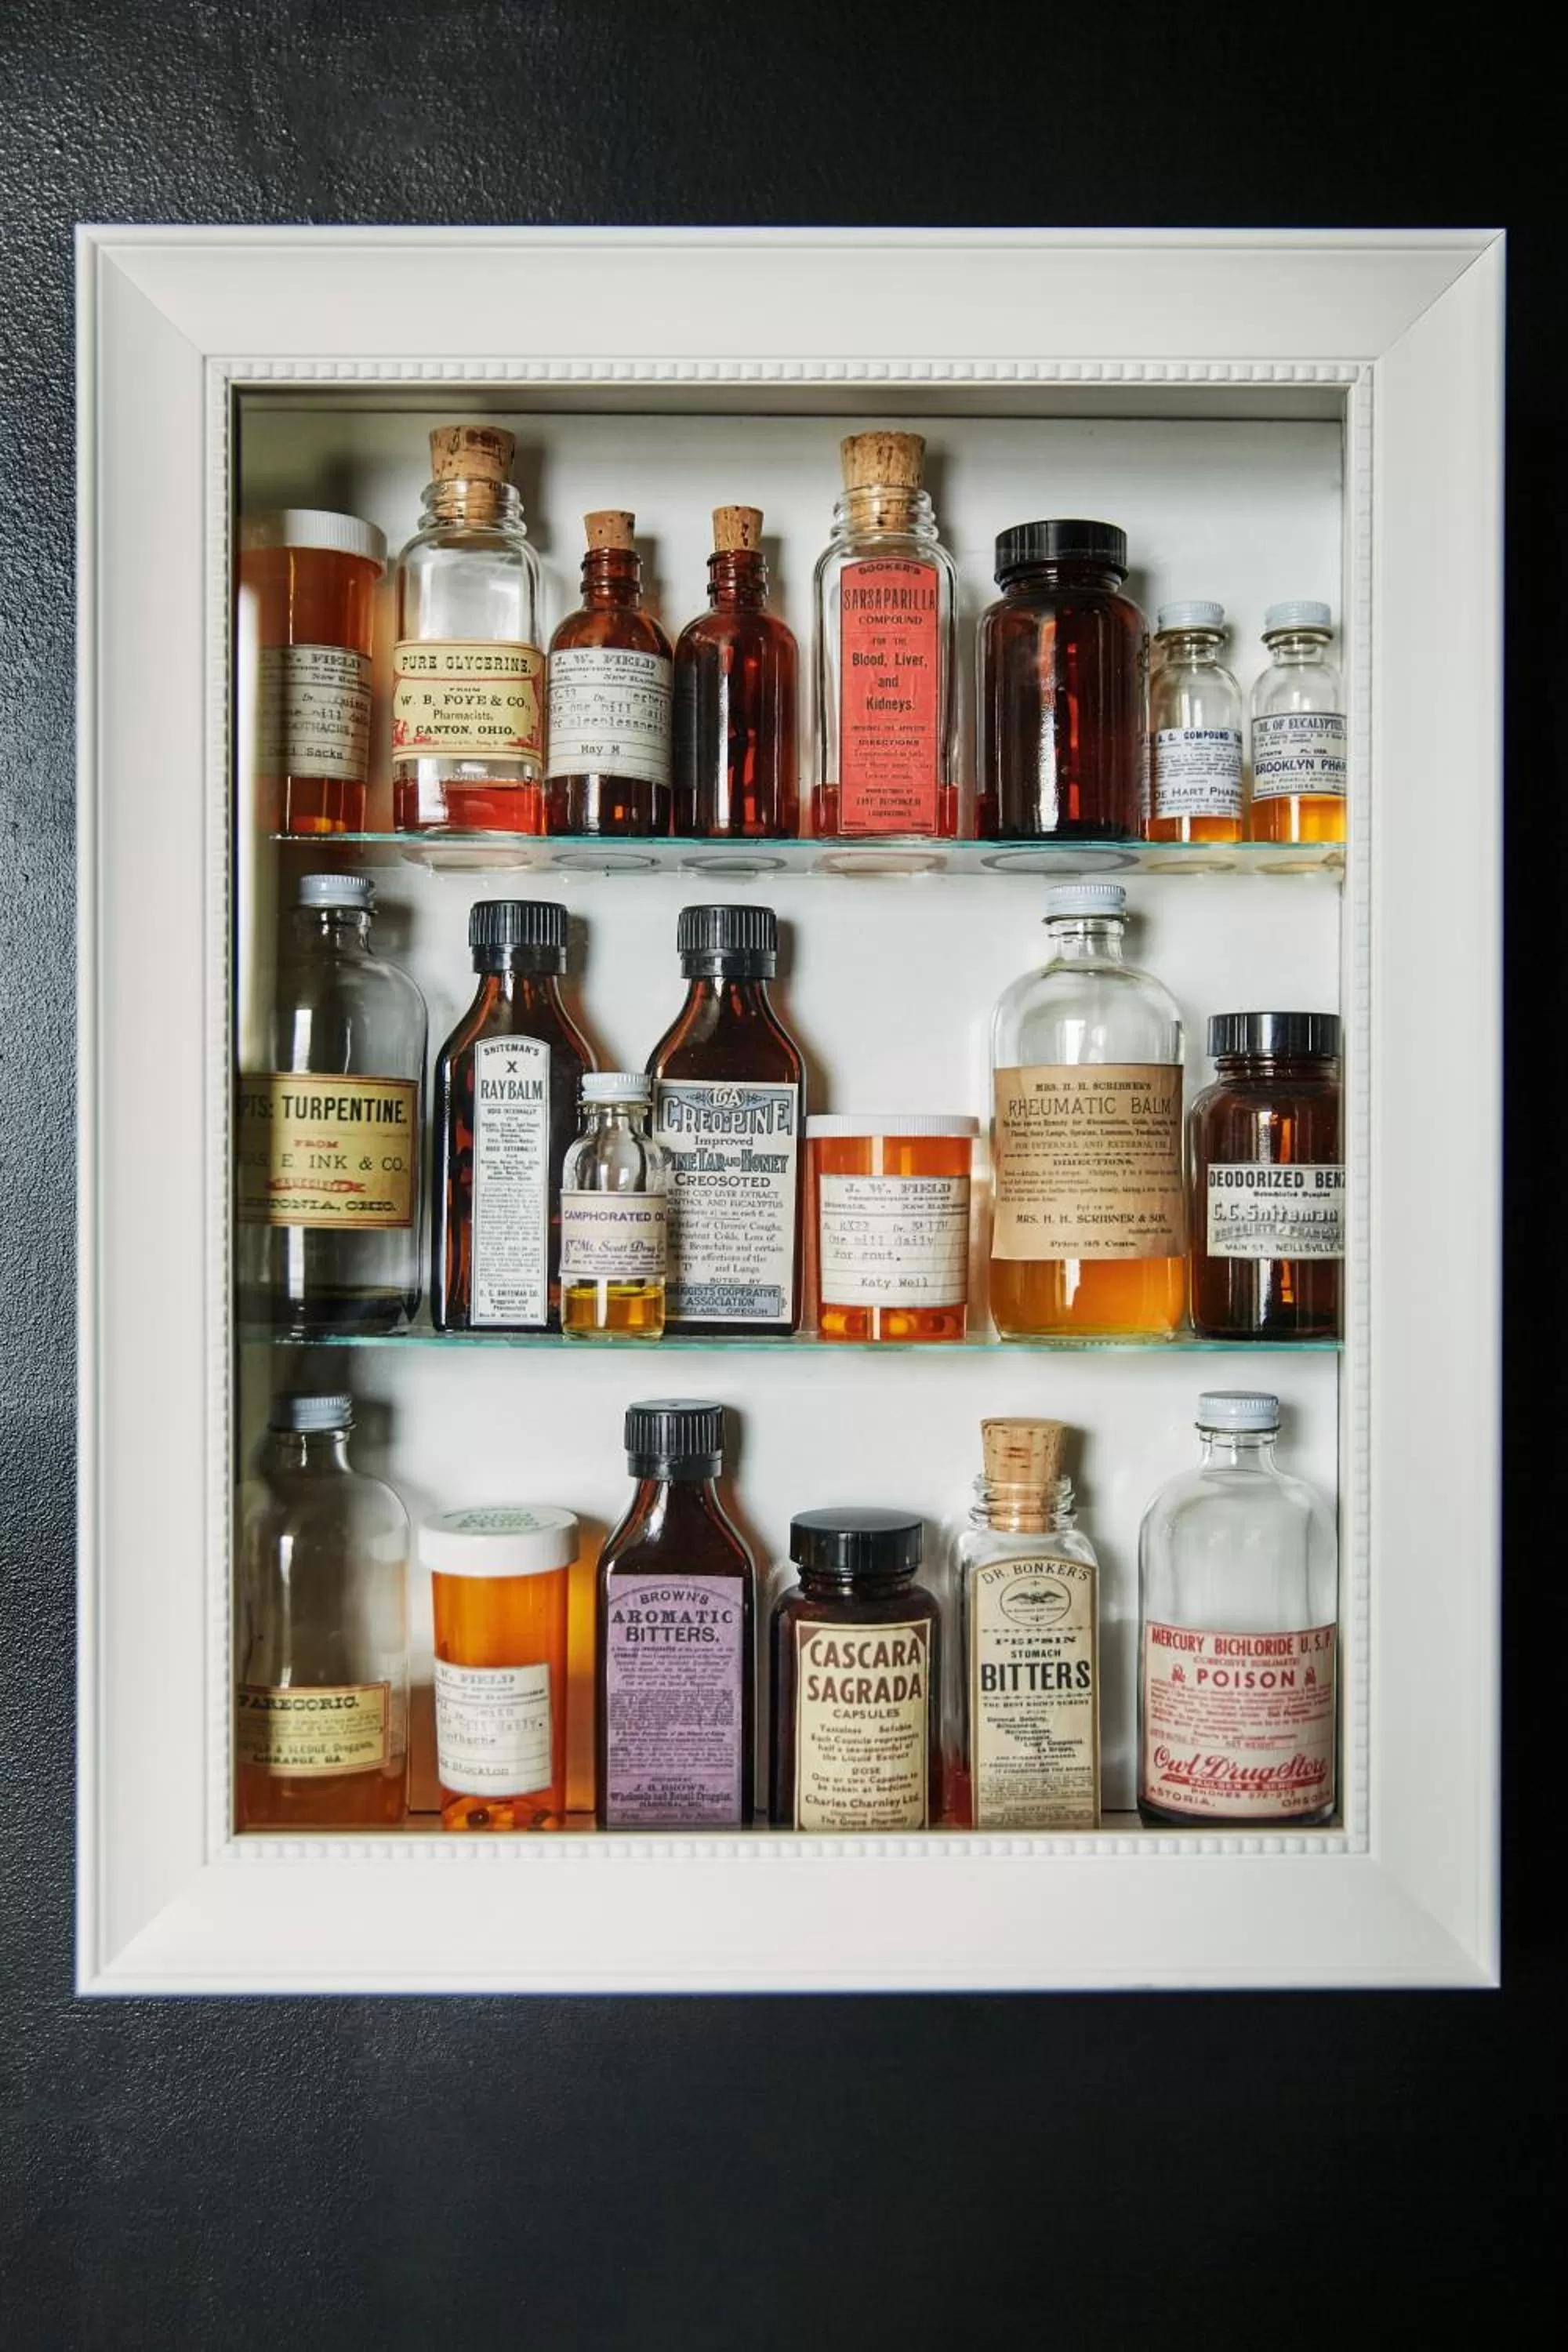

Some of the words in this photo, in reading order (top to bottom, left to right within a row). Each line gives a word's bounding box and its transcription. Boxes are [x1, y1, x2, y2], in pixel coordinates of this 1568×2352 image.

[844, 589, 935, 611] SARSAPARILLA
[858, 615, 923, 625] COMPOUND
[401, 655, 437, 670] PURE
[446, 655, 532, 673] GLYCERINE.
[603, 654, 655, 670] FIELD
[852, 652, 887, 667] Blood,
[895, 652, 927, 668] Liver,
[877, 675, 899, 688] and
[444, 695, 487, 705] FOYE
[491, 695, 502, 705] &
[866, 697, 916, 713] Kidneys.
[1273, 720, 1285, 729] OF
[1255, 759, 1315, 775] BROOKLYN
[1172, 787, 1203, 797] HART
[506, 1061, 519, 1073] X
[281, 1095, 408, 1124] TURPENTINE.
[1008, 1097, 1117, 1118] RHEUMATIC
[1131, 1098, 1171, 1114] BALM
[695, 1136, 753, 1149] Improved
[309, 1155, 348, 1170] INK
[359, 1156, 373, 1171] &
[674, 1172, 771, 1187] CREOSOTED
[901, 1182, 952, 1193] FIELD
[1209, 1171, 1305, 1188] DEODORIZED
[345, 1200, 397, 1211] OHIO.
[982, 1567, 1010, 1584] DR.
[1014, 1562, 1091, 1581] BONKER'S
[640, 1591, 709, 1605] BROWN'S
[612, 1610, 733, 1624] AROMATIC
[626, 1626, 720, 1642] BITTERS.
[1152, 1628, 1205, 1652] MERCURY
[1214, 1638, 1293, 1656] BICHLORIDE
[810, 1638, 921, 1669] CASCARA
[1011, 1649, 1062, 1658] STOMACH
[982, 1661, 1091, 1692] BITTERS
[1197, 1668, 1295, 1688] POISON
[807, 1672, 922, 1704] SAGRADA
[833, 1708, 901, 1719] CAPSULES
[1154, 1744, 1201, 1776] Owl
[1200, 1755, 1276, 1782] Drug
[805, 1794, 848, 1807] Charles
[1149, 1786, 1216, 1807] ASTORIA,
